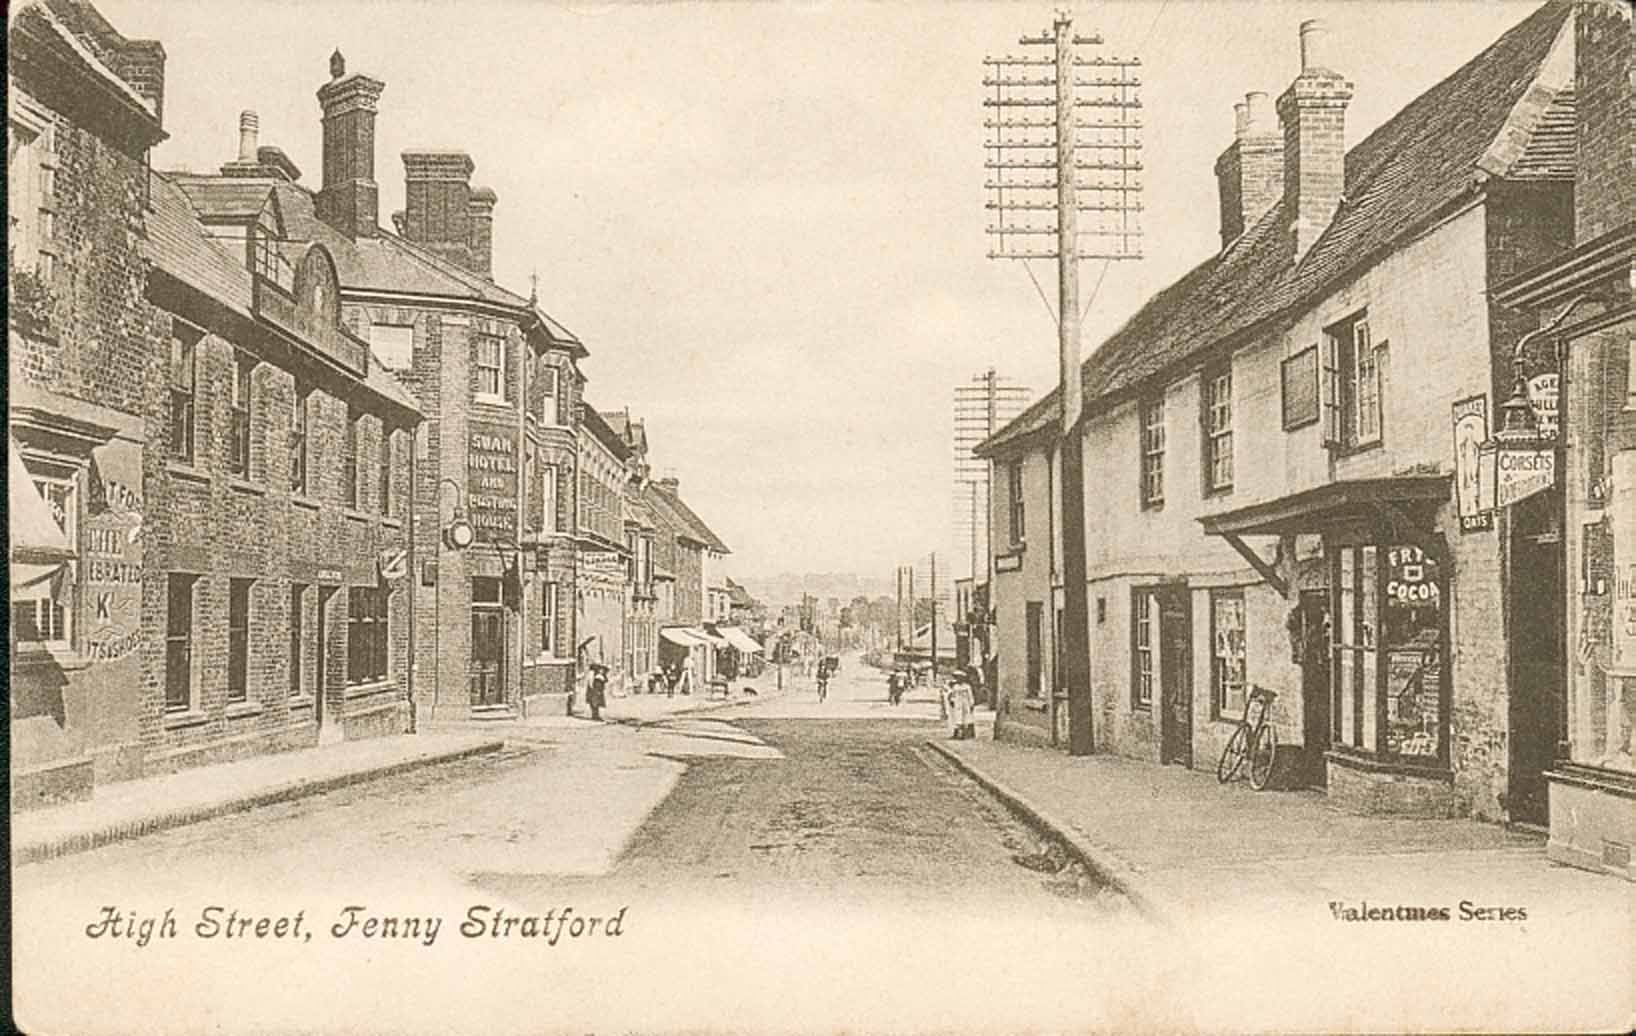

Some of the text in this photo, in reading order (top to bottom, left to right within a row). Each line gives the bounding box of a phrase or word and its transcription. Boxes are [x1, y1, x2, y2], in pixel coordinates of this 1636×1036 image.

[471, 435, 512, 453] SWAN
[468, 453, 517, 474] HOTEL
[1500, 453, 1554, 471] CORSETS
[480, 477, 505, 490] AND
[471, 513, 513, 531] HOUSE
[1387, 581, 1440, 600] COCOA
